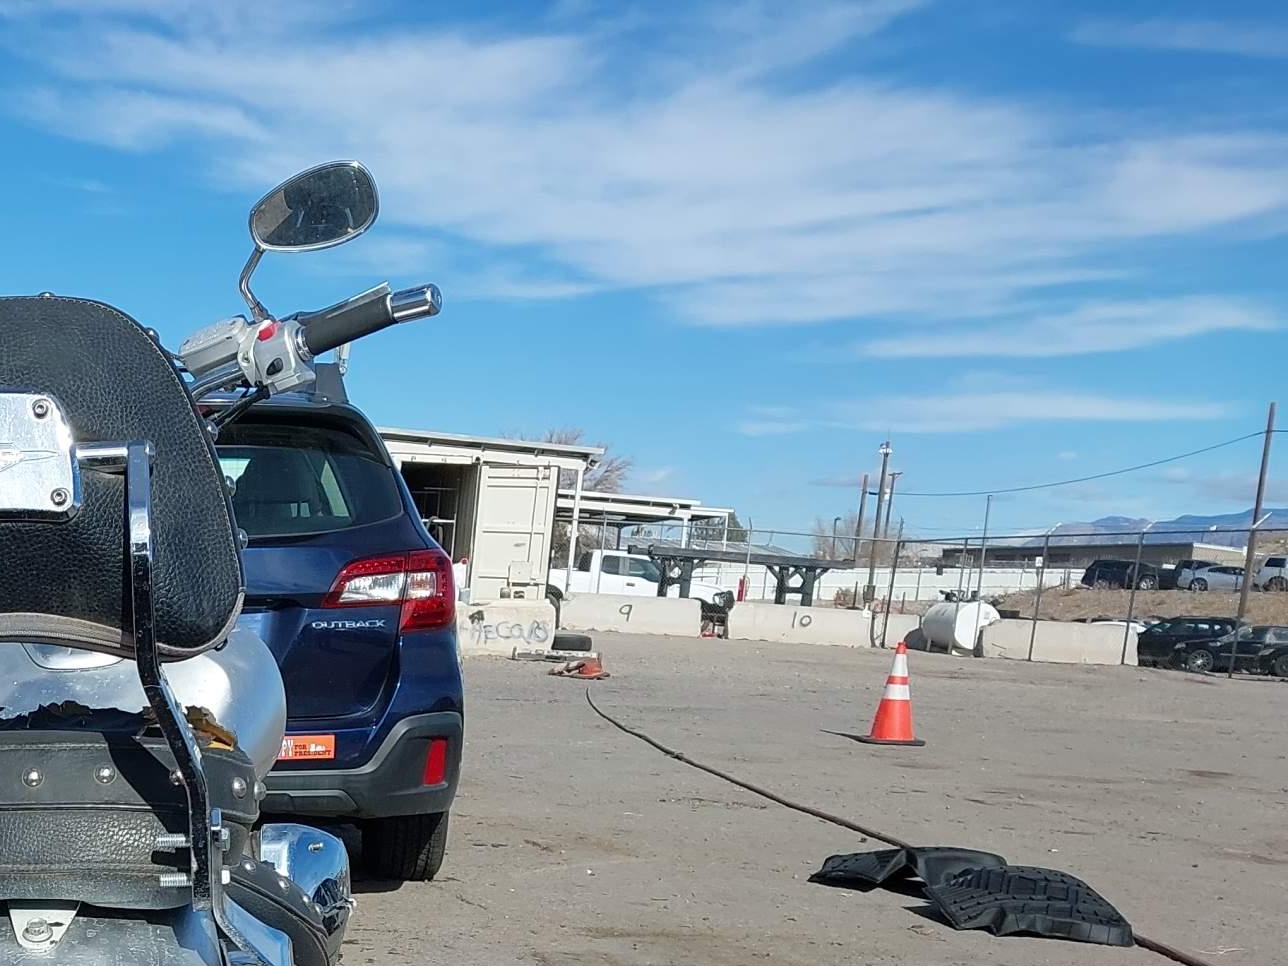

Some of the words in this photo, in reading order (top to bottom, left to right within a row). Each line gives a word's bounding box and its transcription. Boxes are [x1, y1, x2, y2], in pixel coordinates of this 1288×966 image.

[619, 604, 632, 622] 9
[792, 611, 812, 629] 10
[312, 619, 385, 629] OUTBACK
